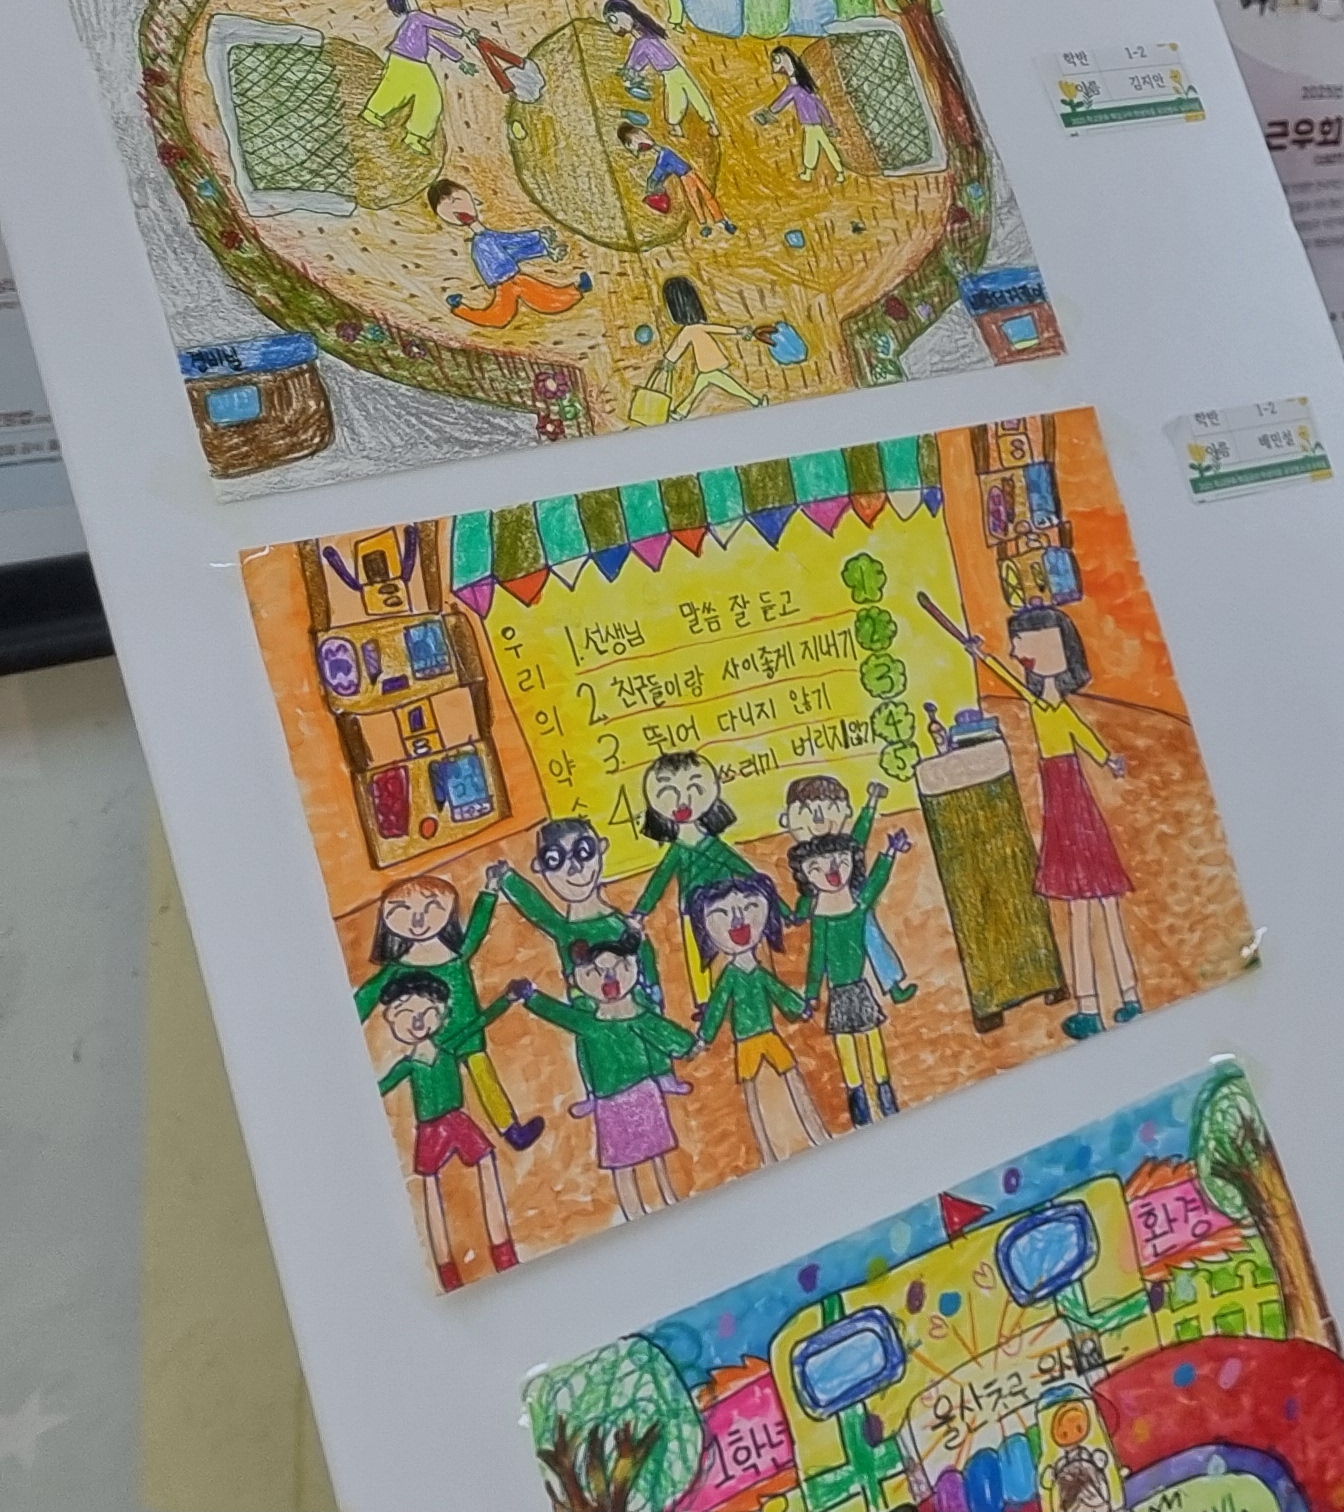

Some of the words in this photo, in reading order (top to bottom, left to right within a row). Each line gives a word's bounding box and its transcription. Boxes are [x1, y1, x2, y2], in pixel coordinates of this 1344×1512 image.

[1124, 46, 1147, 59] 1-2
[584, 619, 646, 657] 선생님
[678, 601, 723, 635] 말씀
[730, 595, 750, 628] 잘
[759, 590, 800, 622] 듣고
[612, 663, 705, 710] 친구들이랑
[722, 641, 796, 682] 사이좋게
[800, 627, 859, 663] 지내기
[643, 718, 700, 758] 뛰어
[718, 700, 777, 734] 다니지
[789, 684, 832, 717] 않기
[1134, 1185, 1212, 1260] 환경
